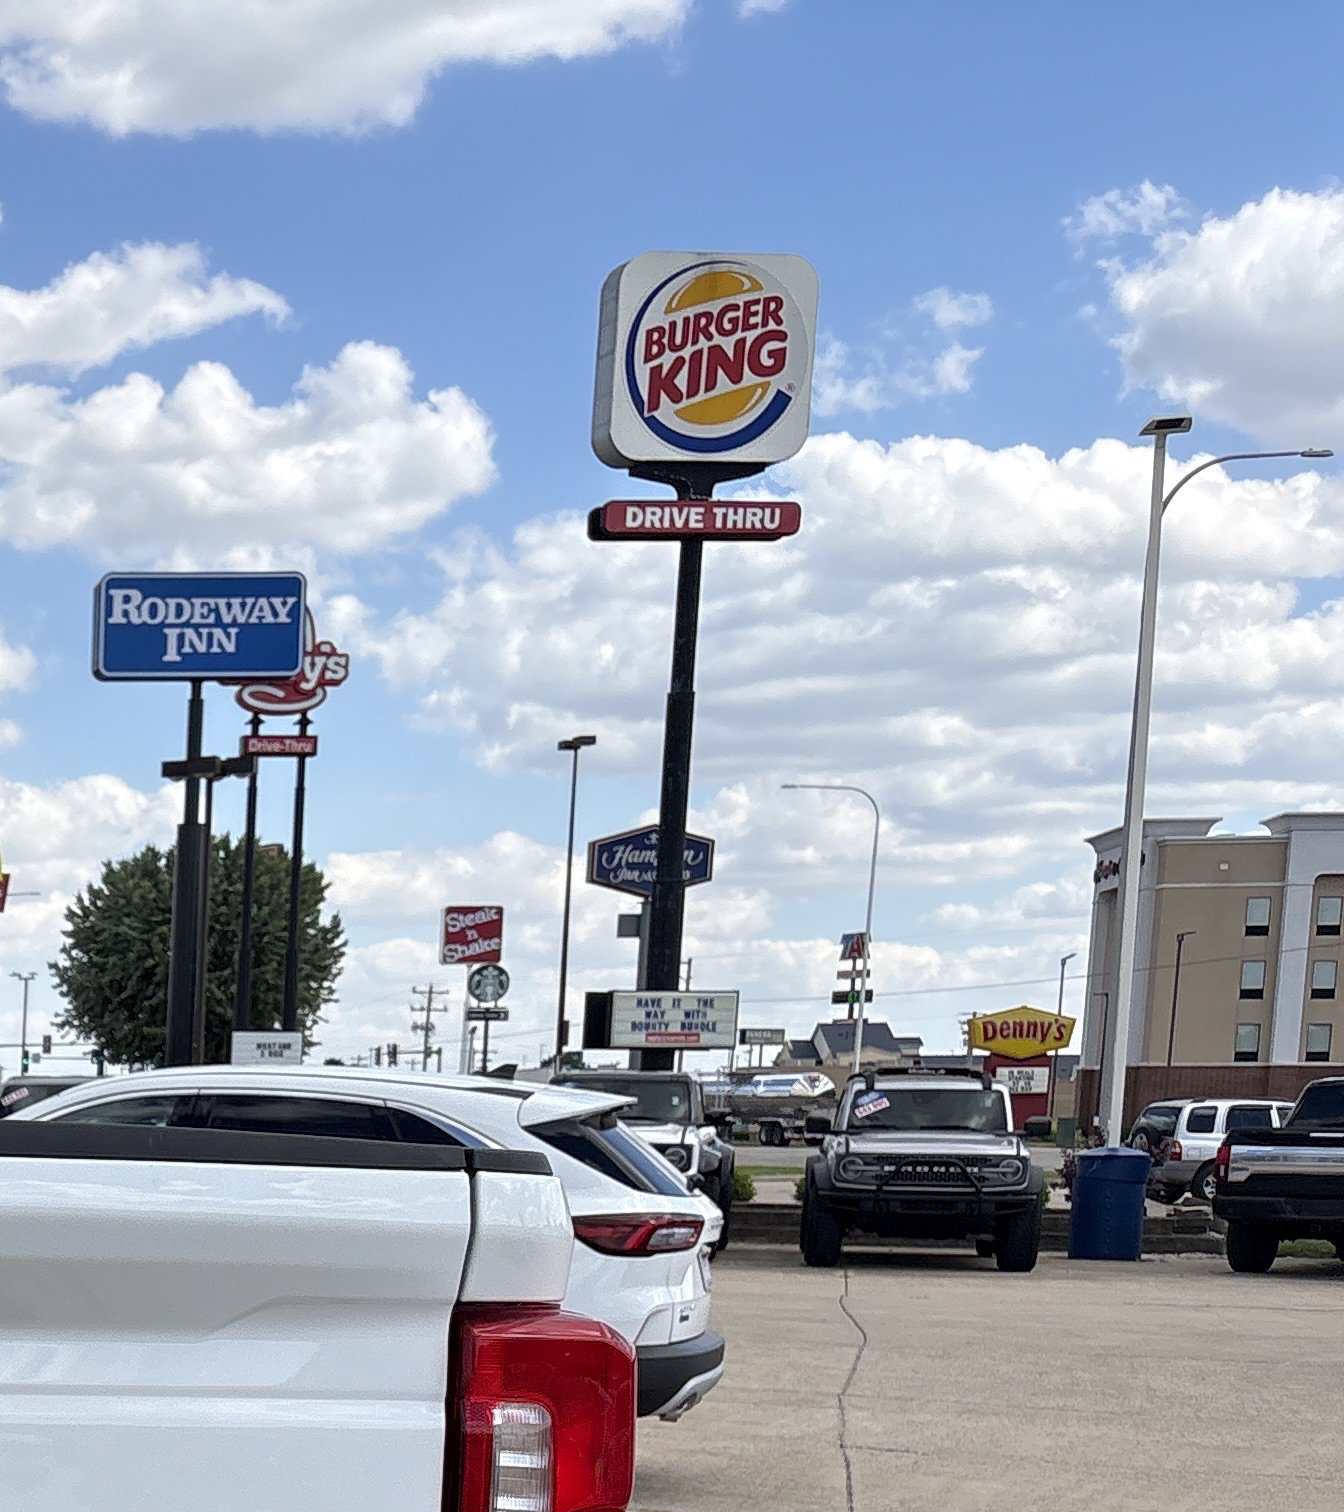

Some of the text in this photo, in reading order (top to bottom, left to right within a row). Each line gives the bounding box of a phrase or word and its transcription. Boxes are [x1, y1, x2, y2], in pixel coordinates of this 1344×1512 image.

[644, 295, 784, 364] BURGER
[647, 329, 788, 414] KING
[625, 506, 781, 529] DRIVE THRU
[108, 588, 298, 625] RODEWAY
[162, 627, 240, 662] INN
[602, 845, 704, 869] Hamn
[445, 907, 501, 933] Steak
[443, 937, 501, 963] Shake
[636, 997, 662, 1008] HAVE
[672, 998, 681, 1008] IT
[645, 1009, 665, 1019] WAY
[982, 1018, 1067, 1044] Denny's
